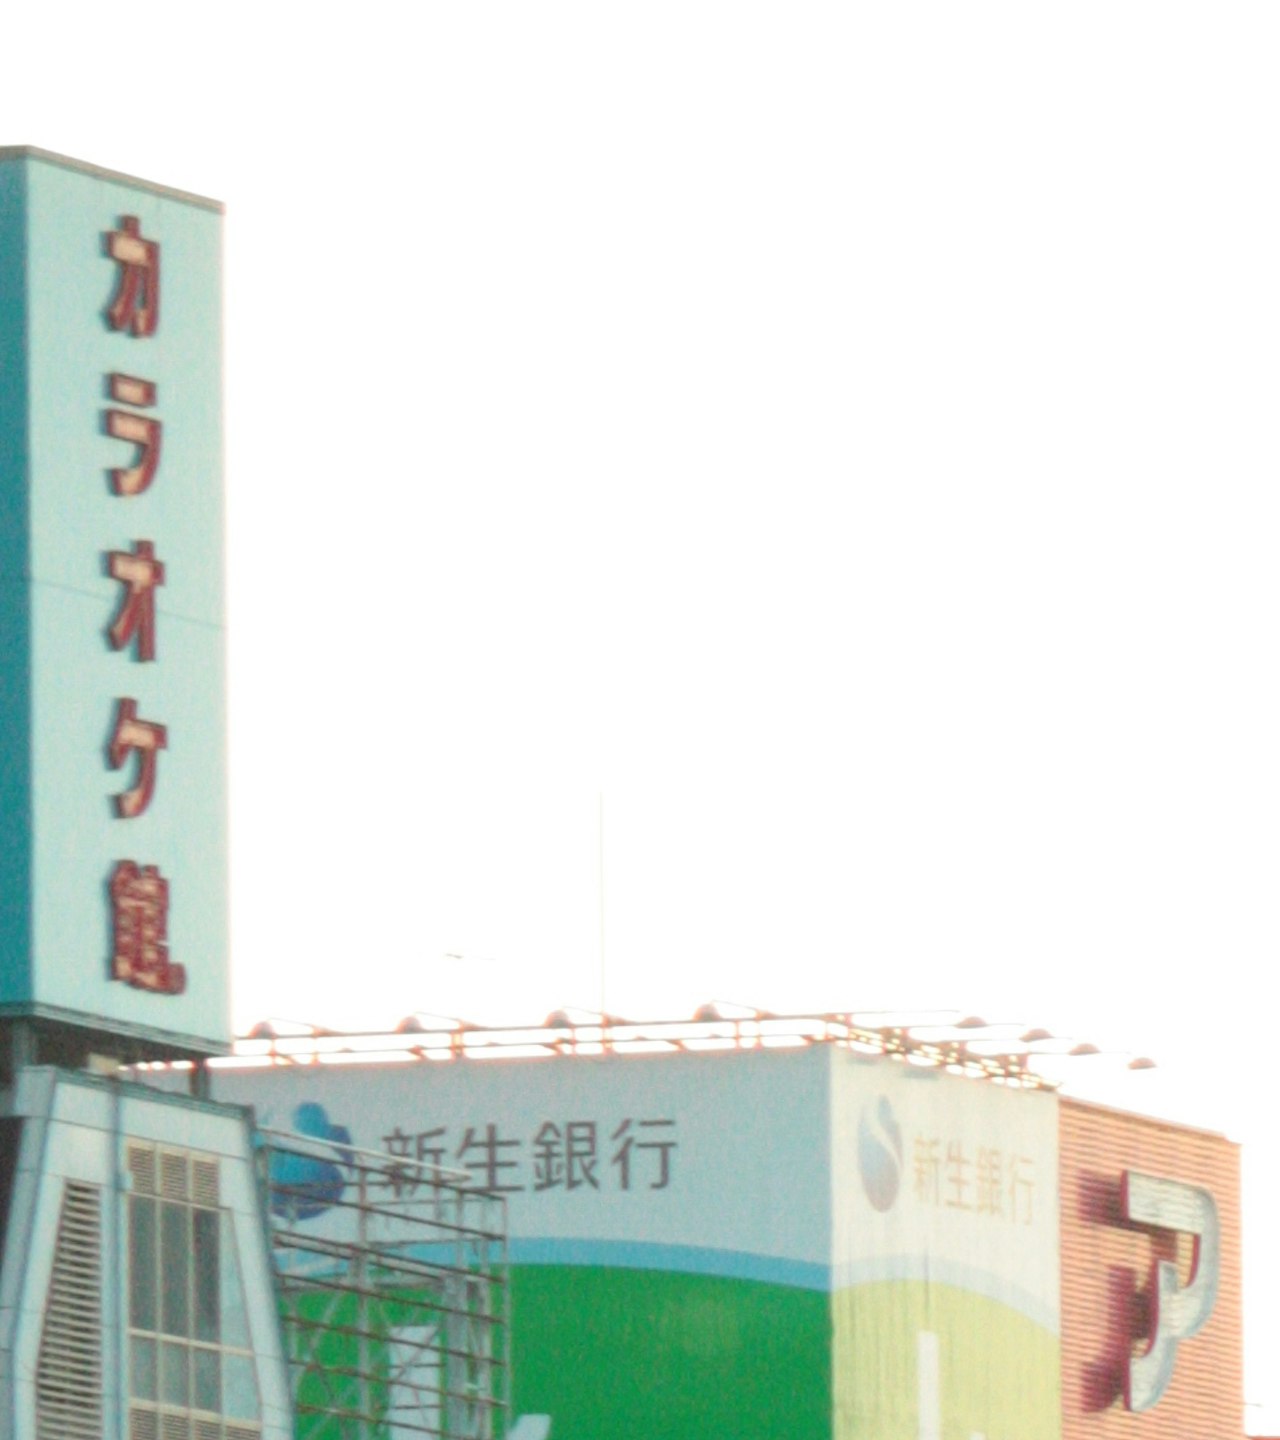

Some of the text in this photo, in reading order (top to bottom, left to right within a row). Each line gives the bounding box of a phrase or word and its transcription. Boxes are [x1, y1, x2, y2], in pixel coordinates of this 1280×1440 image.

[382, 1116, 678, 1197] 新生銀行
[910, 1136, 1036, 1228] 新生銀行
